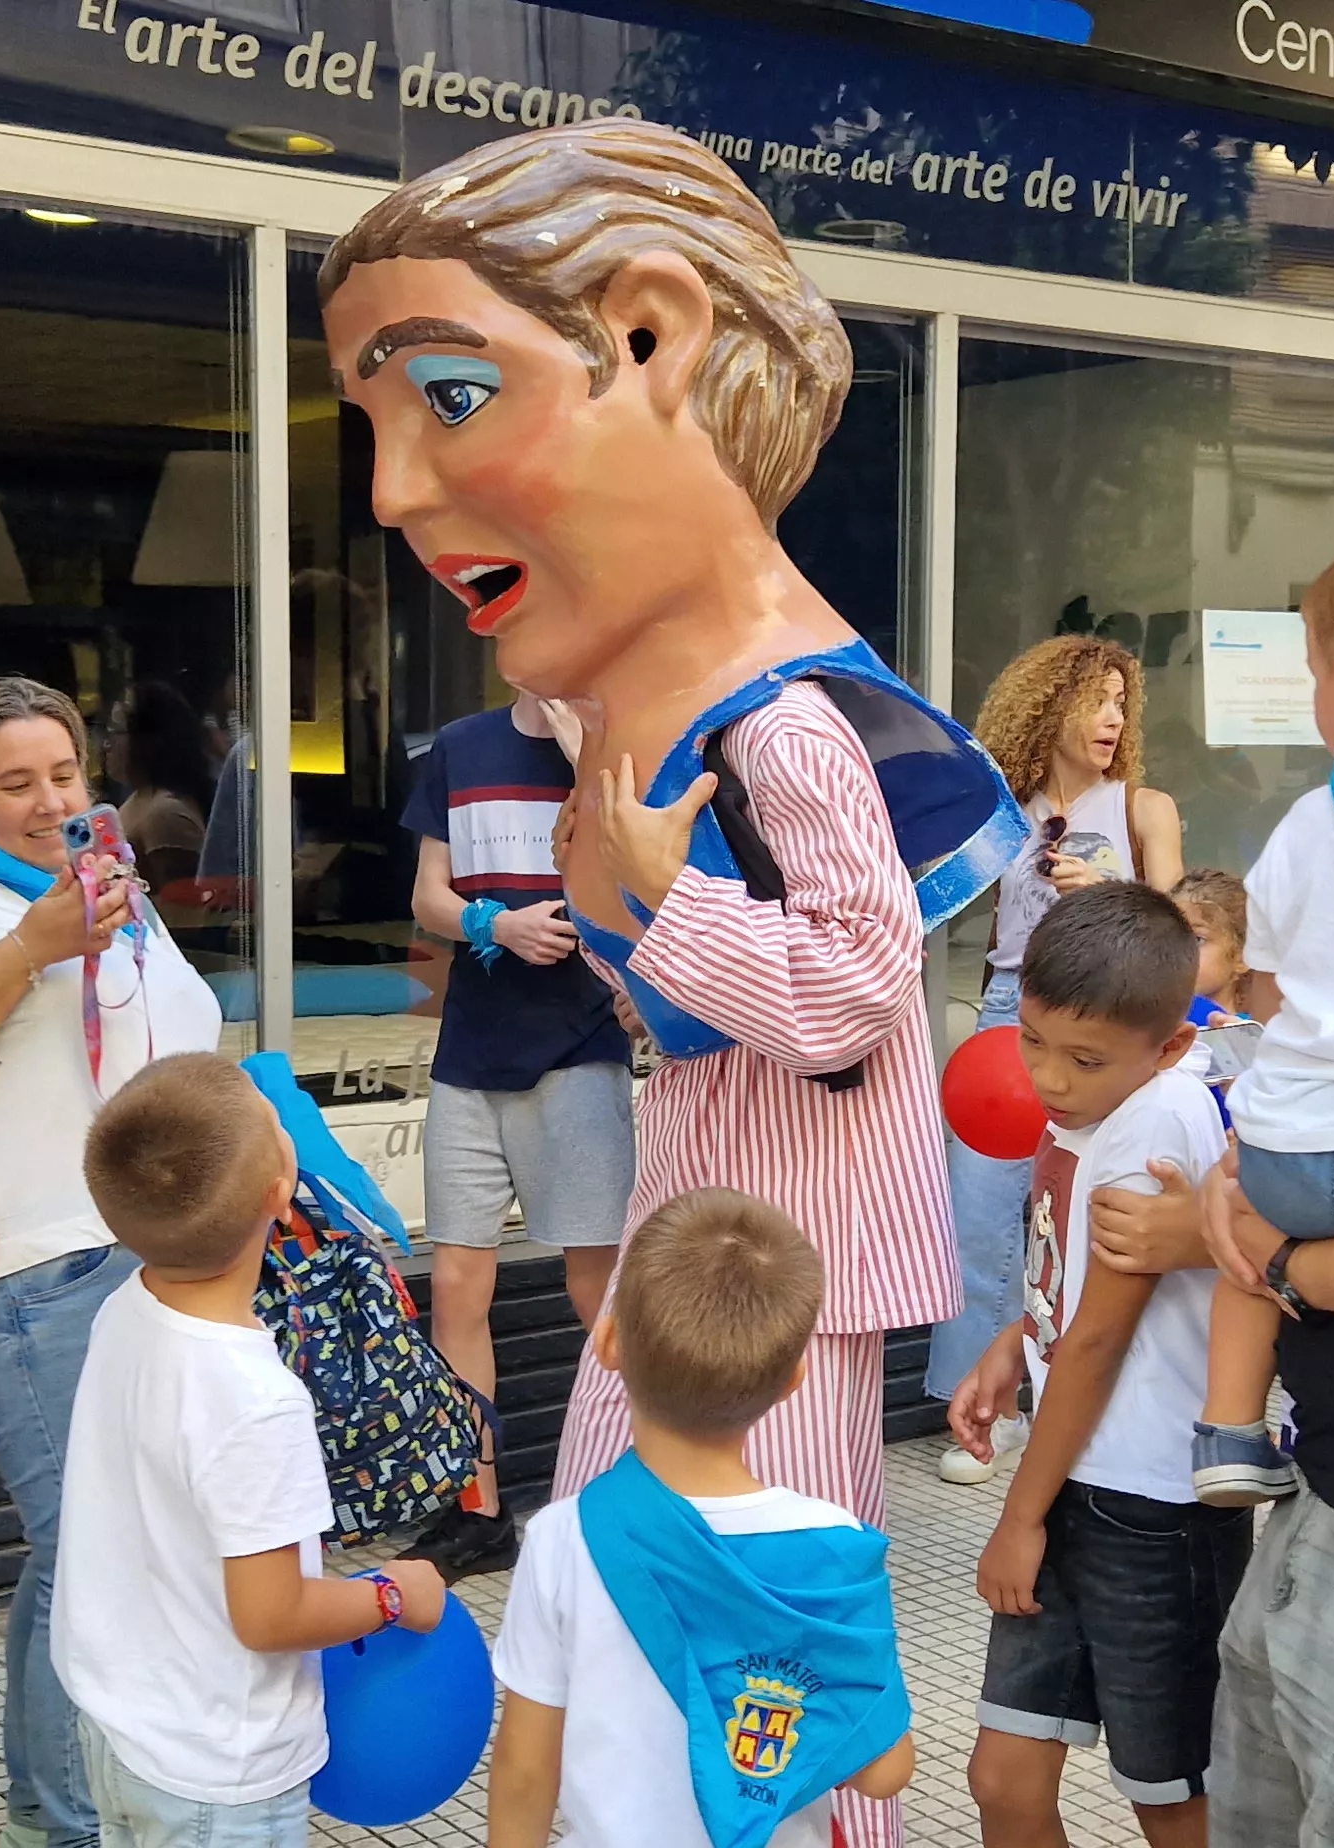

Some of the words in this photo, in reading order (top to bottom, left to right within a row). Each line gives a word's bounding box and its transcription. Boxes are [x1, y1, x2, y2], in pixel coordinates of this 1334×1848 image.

[77, 0, 119, 34] El
[125, 17, 261, 79] arte
[284, 31, 377, 100] del
[759, 140, 842, 177] parte
[851, 149, 895, 186] del
[912, 150, 1009, 202] arte
[1024, 157, 1077, 212] de
[1092, 169, 1189, 228] vivir
[333, 1050, 386, 1097] La
[735, 1653, 770, 1676] SAN
[775, 1656, 826, 1695] MATEO
